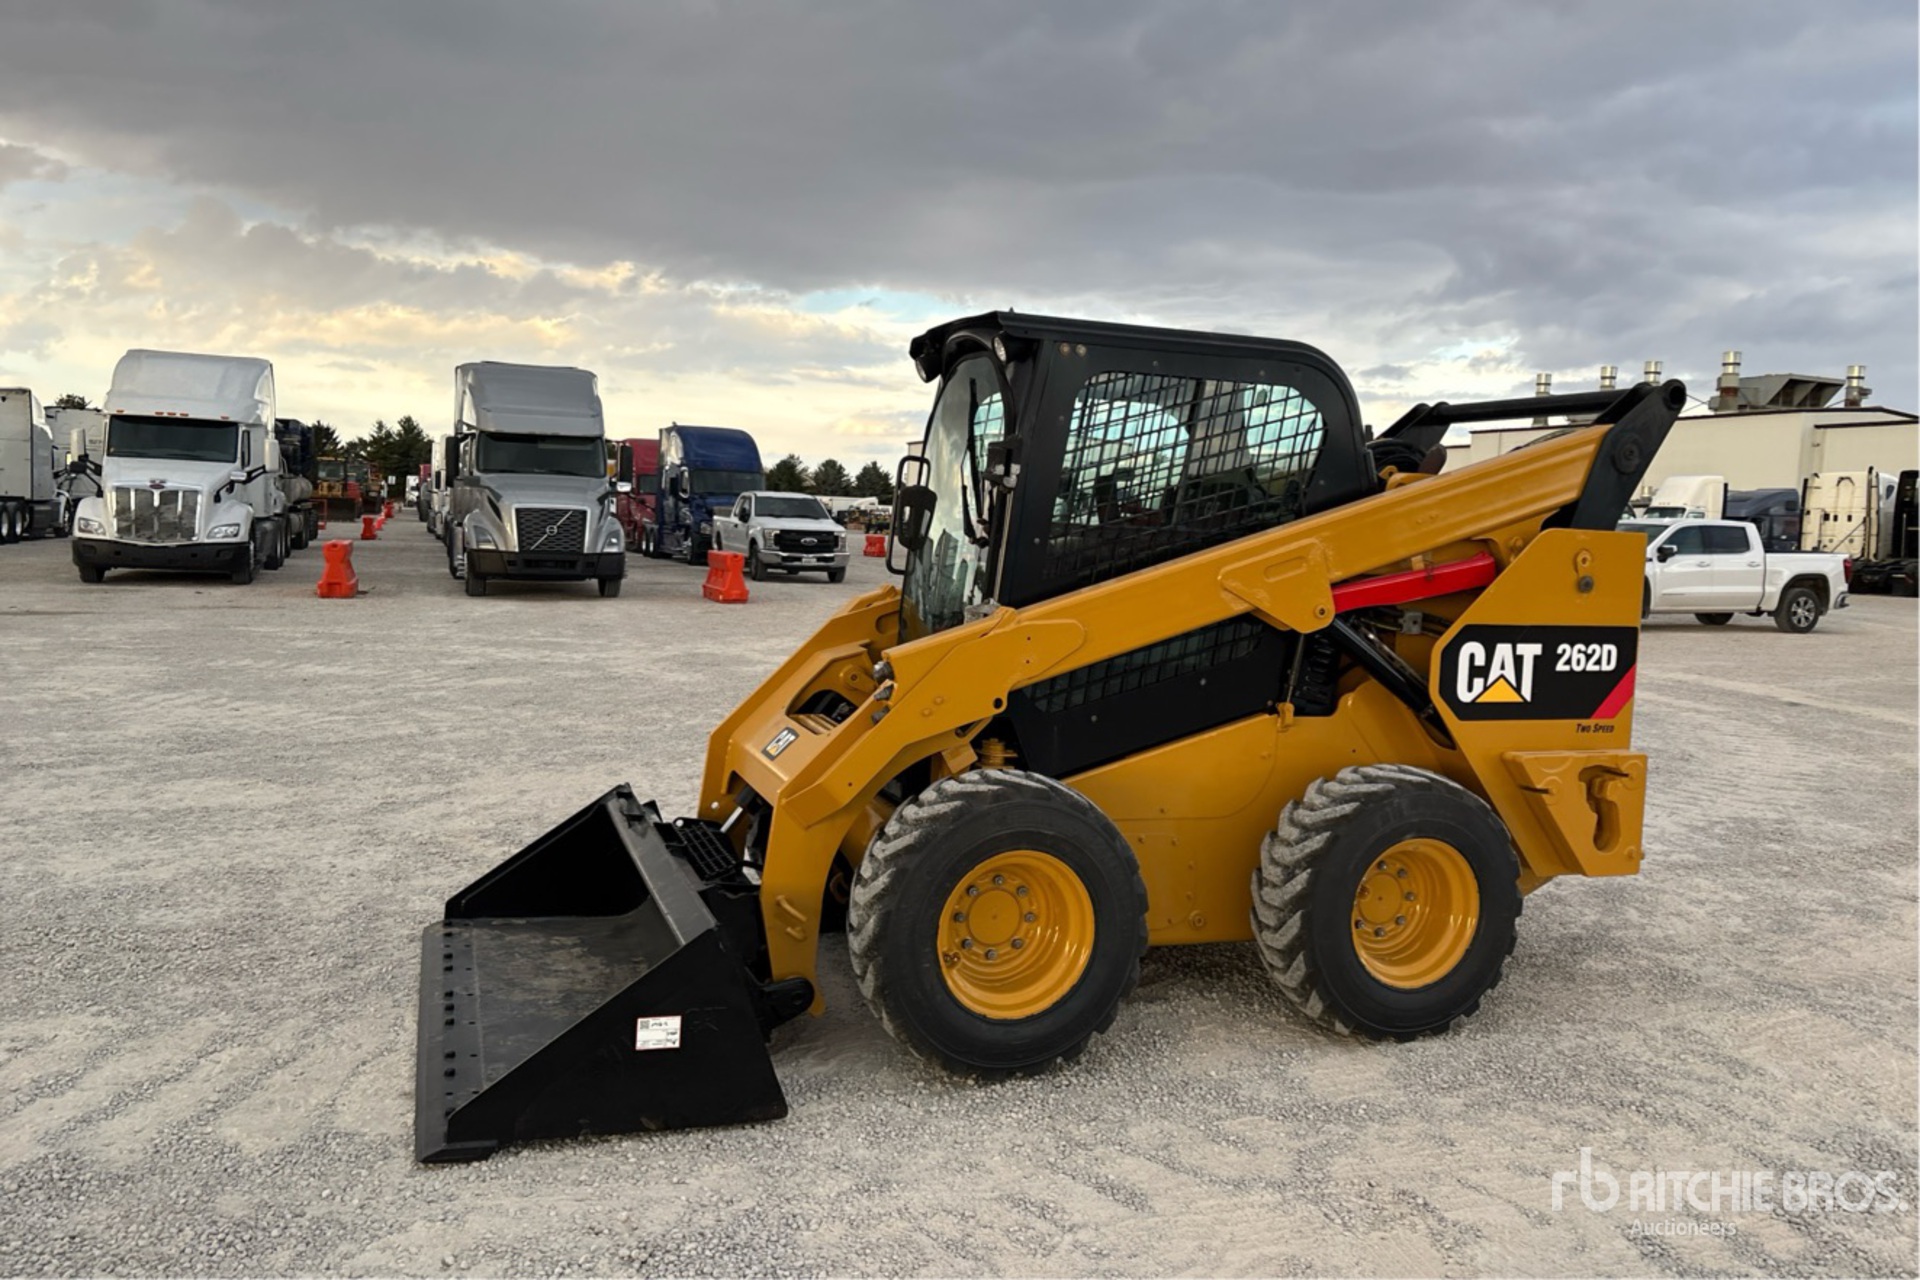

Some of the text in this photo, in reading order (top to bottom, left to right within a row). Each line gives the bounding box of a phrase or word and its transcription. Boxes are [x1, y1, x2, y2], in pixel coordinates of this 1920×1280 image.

[1456, 641, 1618, 703] CAT 262D
[765, 729, 797, 757] CAT
